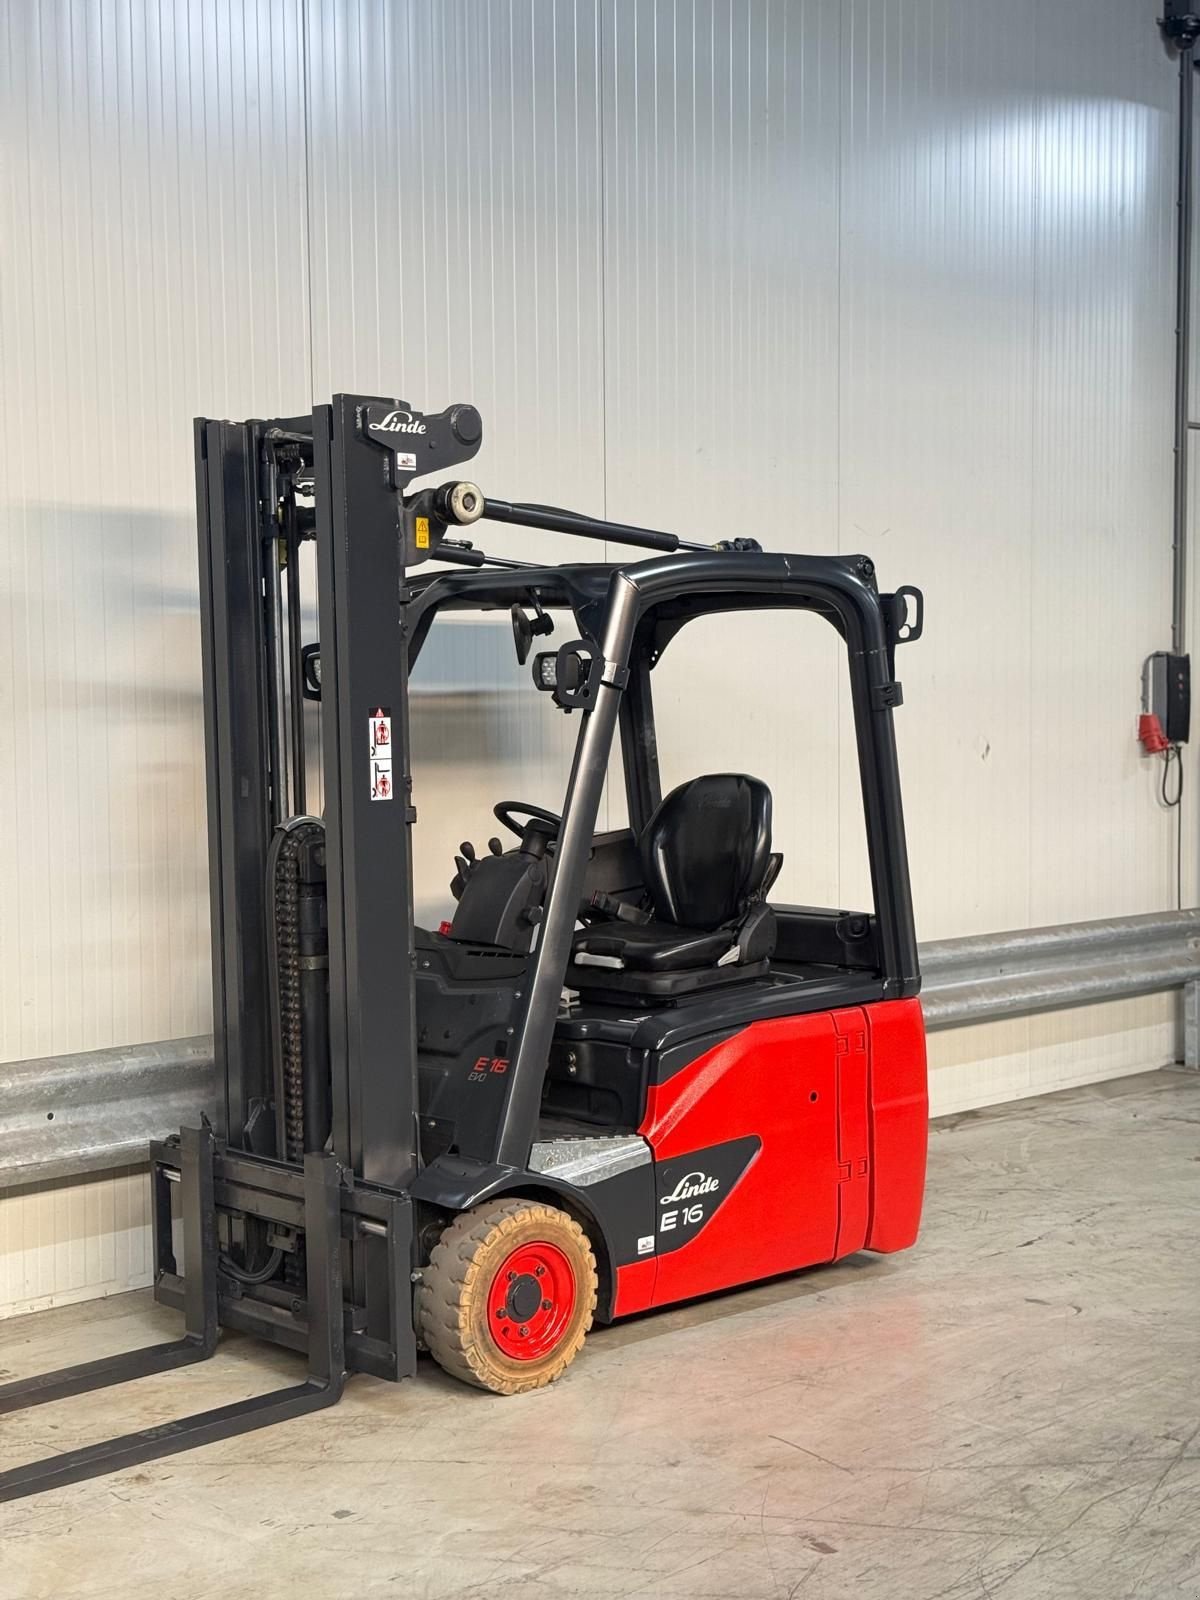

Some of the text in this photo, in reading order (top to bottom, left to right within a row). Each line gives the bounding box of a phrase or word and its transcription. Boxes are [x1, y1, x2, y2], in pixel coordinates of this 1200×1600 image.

[369, 410, 427, 434] Linde
[660, 1171, 720, 1205] Linde
[660, 1204, 704, 1232] E 16
